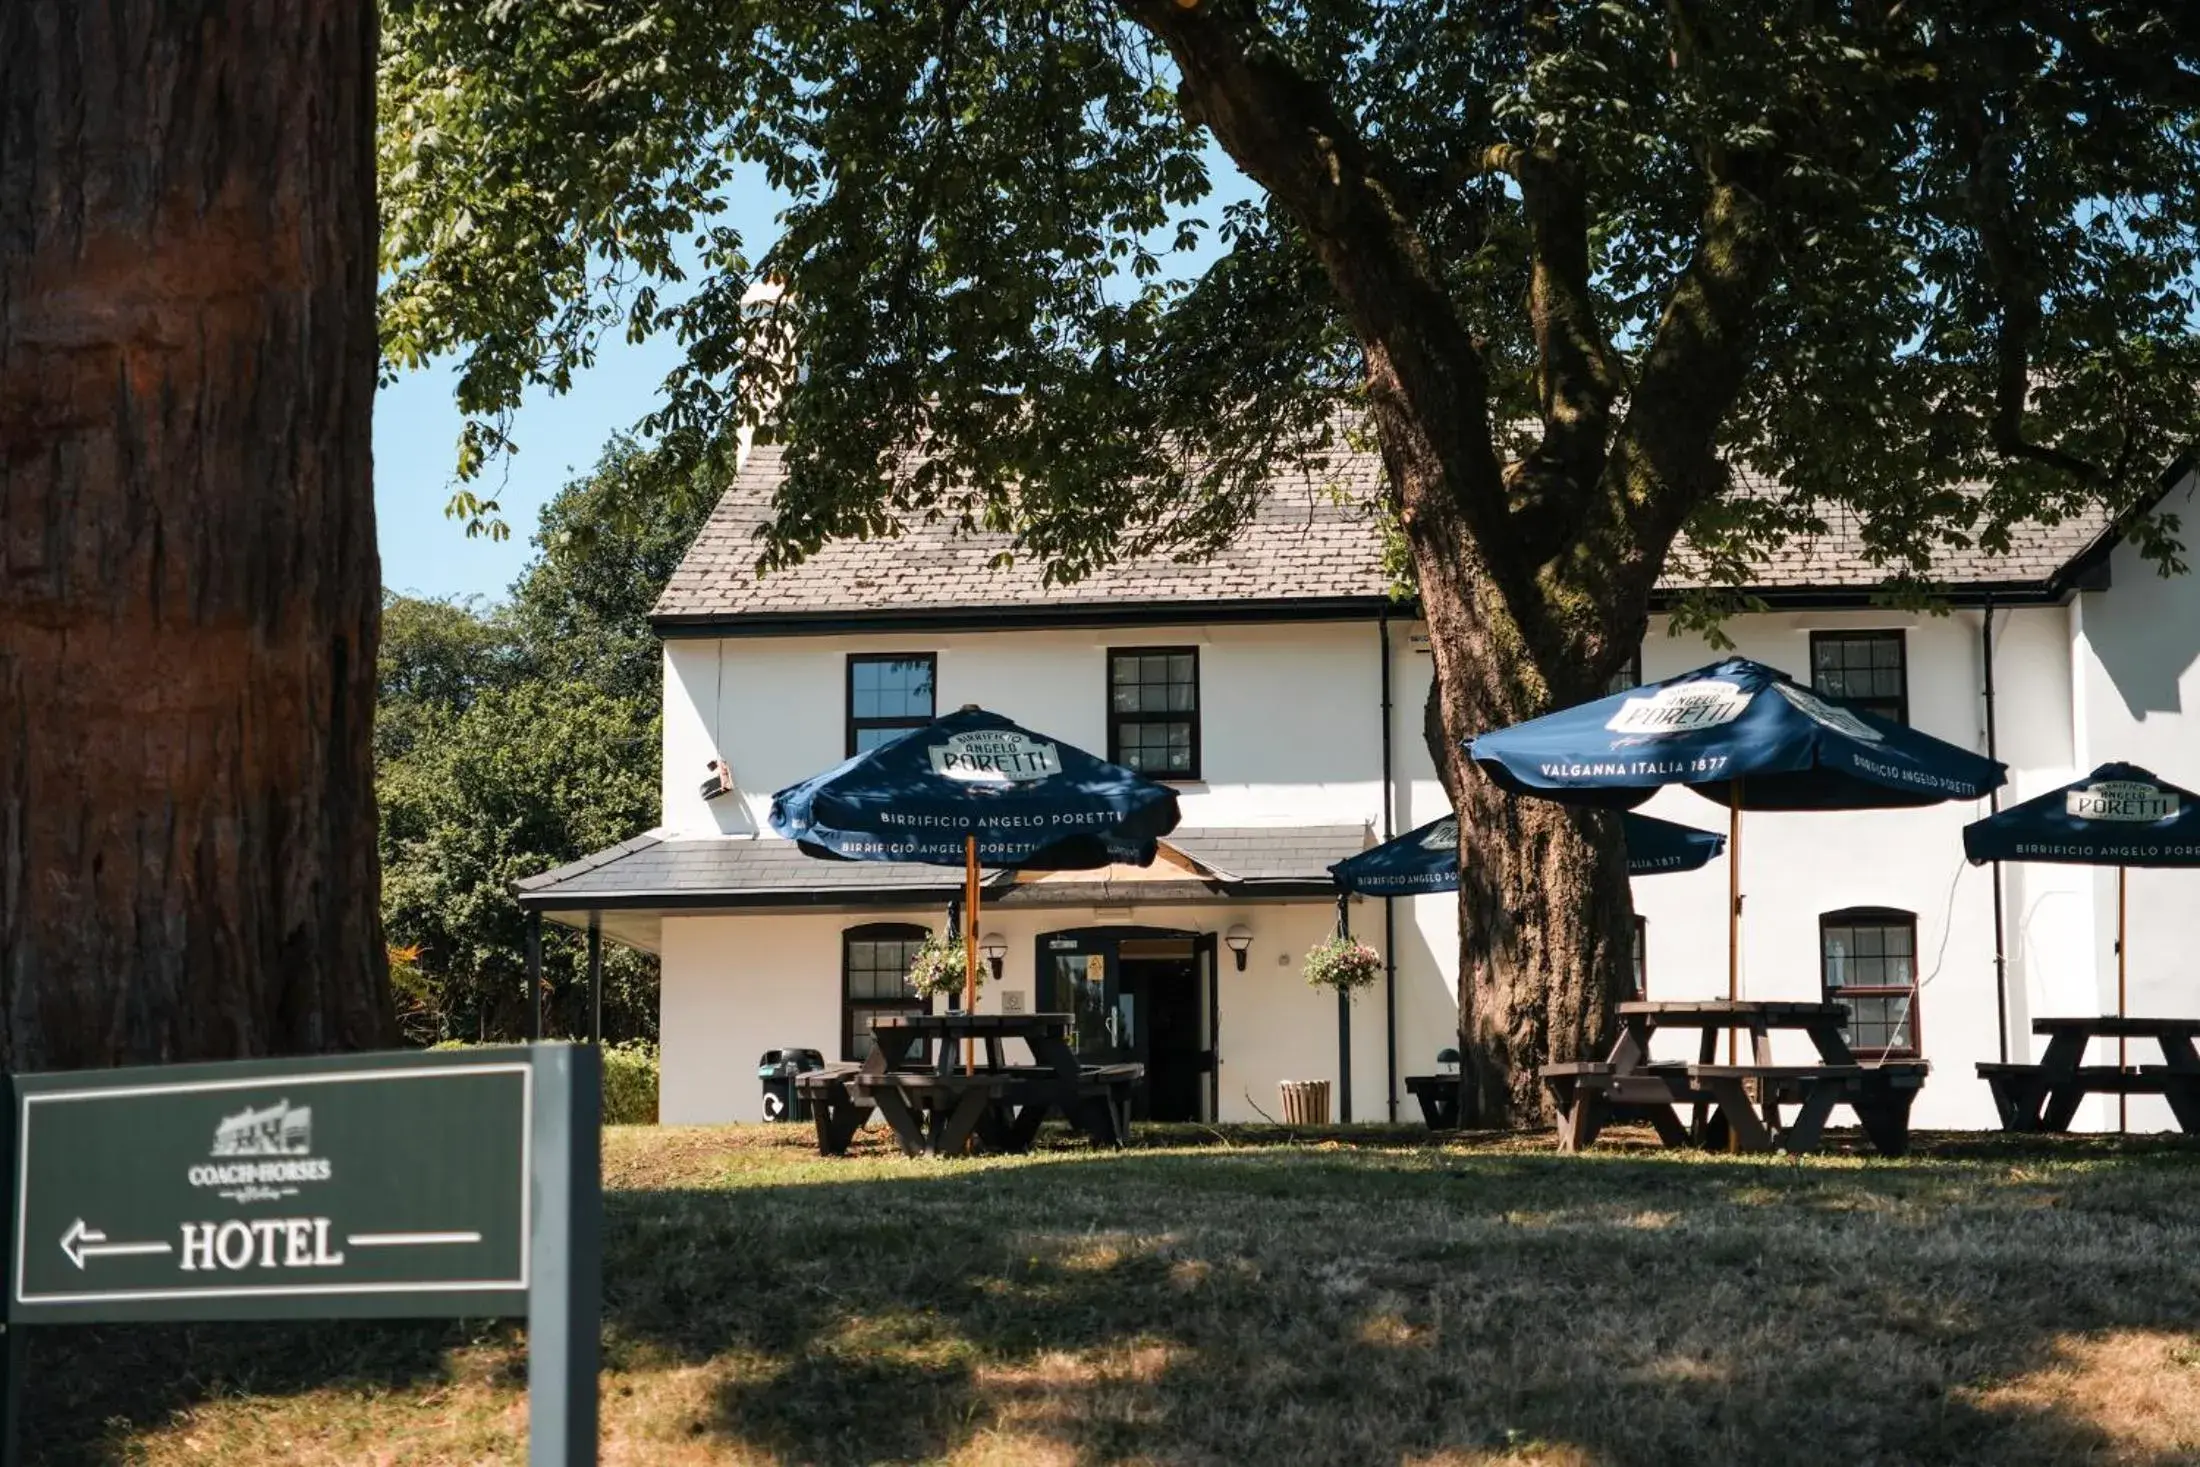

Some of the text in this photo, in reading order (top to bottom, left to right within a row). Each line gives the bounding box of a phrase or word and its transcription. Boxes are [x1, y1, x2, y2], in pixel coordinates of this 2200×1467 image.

[1625, 702, 1736, 725] PORETTI
[965, 743, 1018, 754] ANGELO
[943, 751, 1048, 773] PORETTI
[1541, 756, 1729, 777] VALGANNA ITALIA 1877
[2079, 798, 2168, 815] PORETTI
[880, 810, 1123, 828] BIRRIFICIO ANGELO PORETTI
[842, 842, 1035, 854] BIRRIFICIO ANGEL PORETTI
[2015, 844, 2094, 856] BIRRIFICIO
[2101, 845, 2159, 856] ANGELO
[180, 1217, 345, 1270] HOTEL
